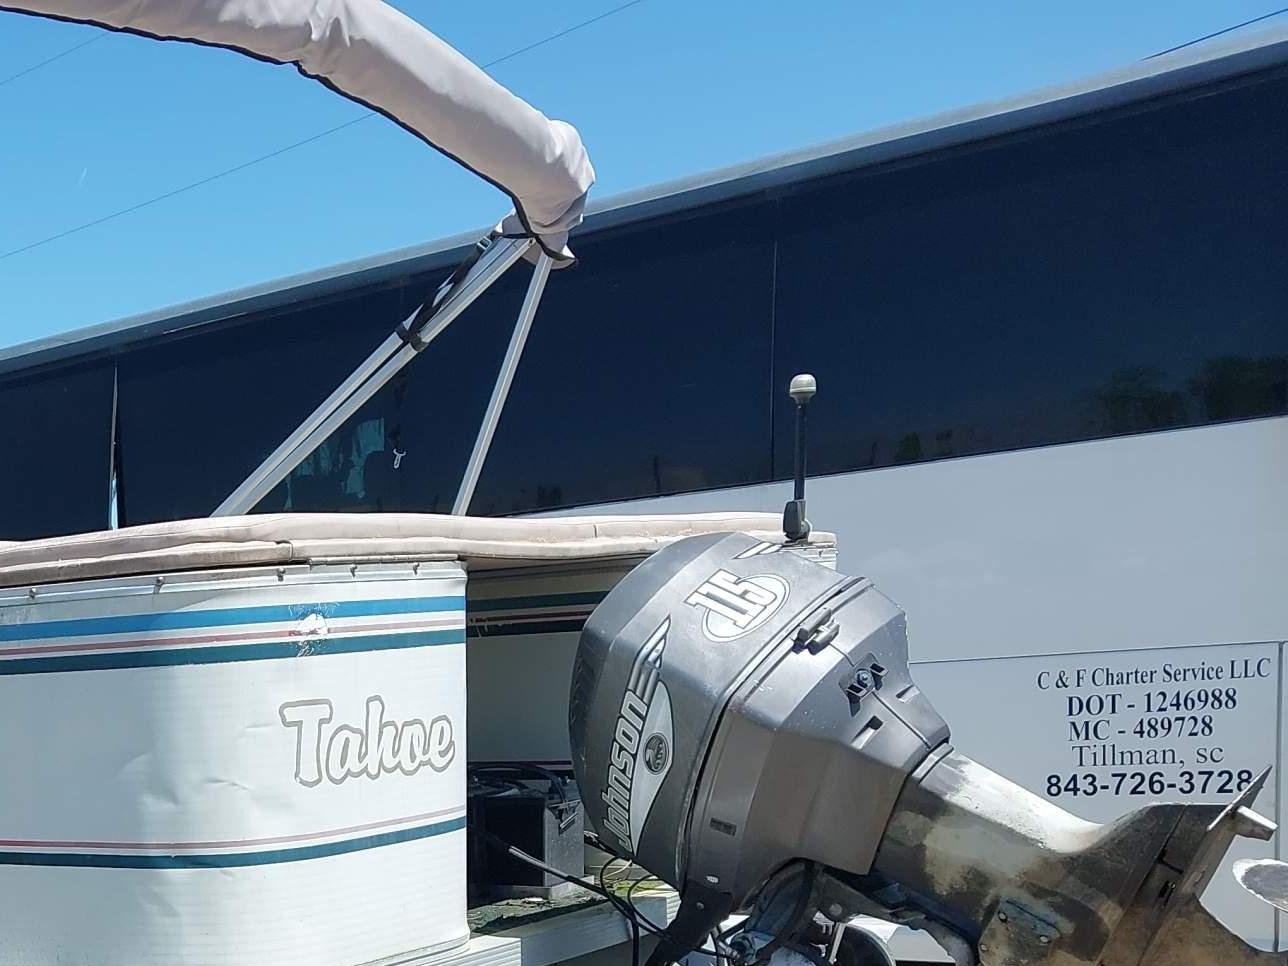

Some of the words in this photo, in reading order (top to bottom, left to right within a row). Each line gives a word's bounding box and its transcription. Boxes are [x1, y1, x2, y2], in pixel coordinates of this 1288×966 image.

[684, 569, 777, 629] 115
[1037, 671, 1050, 690] C
[1055, 670, 1070, 689] &
[1076, 669, 1087, 688] F
[1091, 666, 1158, 687] Charter
[1162, 663, 1224, 683] Service
[1229, 657, 1272, 679] LLC
[1066, 693, 1123, 717] DOT
[1143, 687, 1238, 714] 1246988
[278, 695, 456, 788] Tahoe
[1068, 719, 1111, 742] MC
[1133, 715, 1214, 739] 489728
[601, 690, 649, 851] Johnson
[1071, 745, 1186, 769] Tillman,
[1195, 745, 1224, 764] sc
[1046, 769, 1254, 797] 843-726-3728
